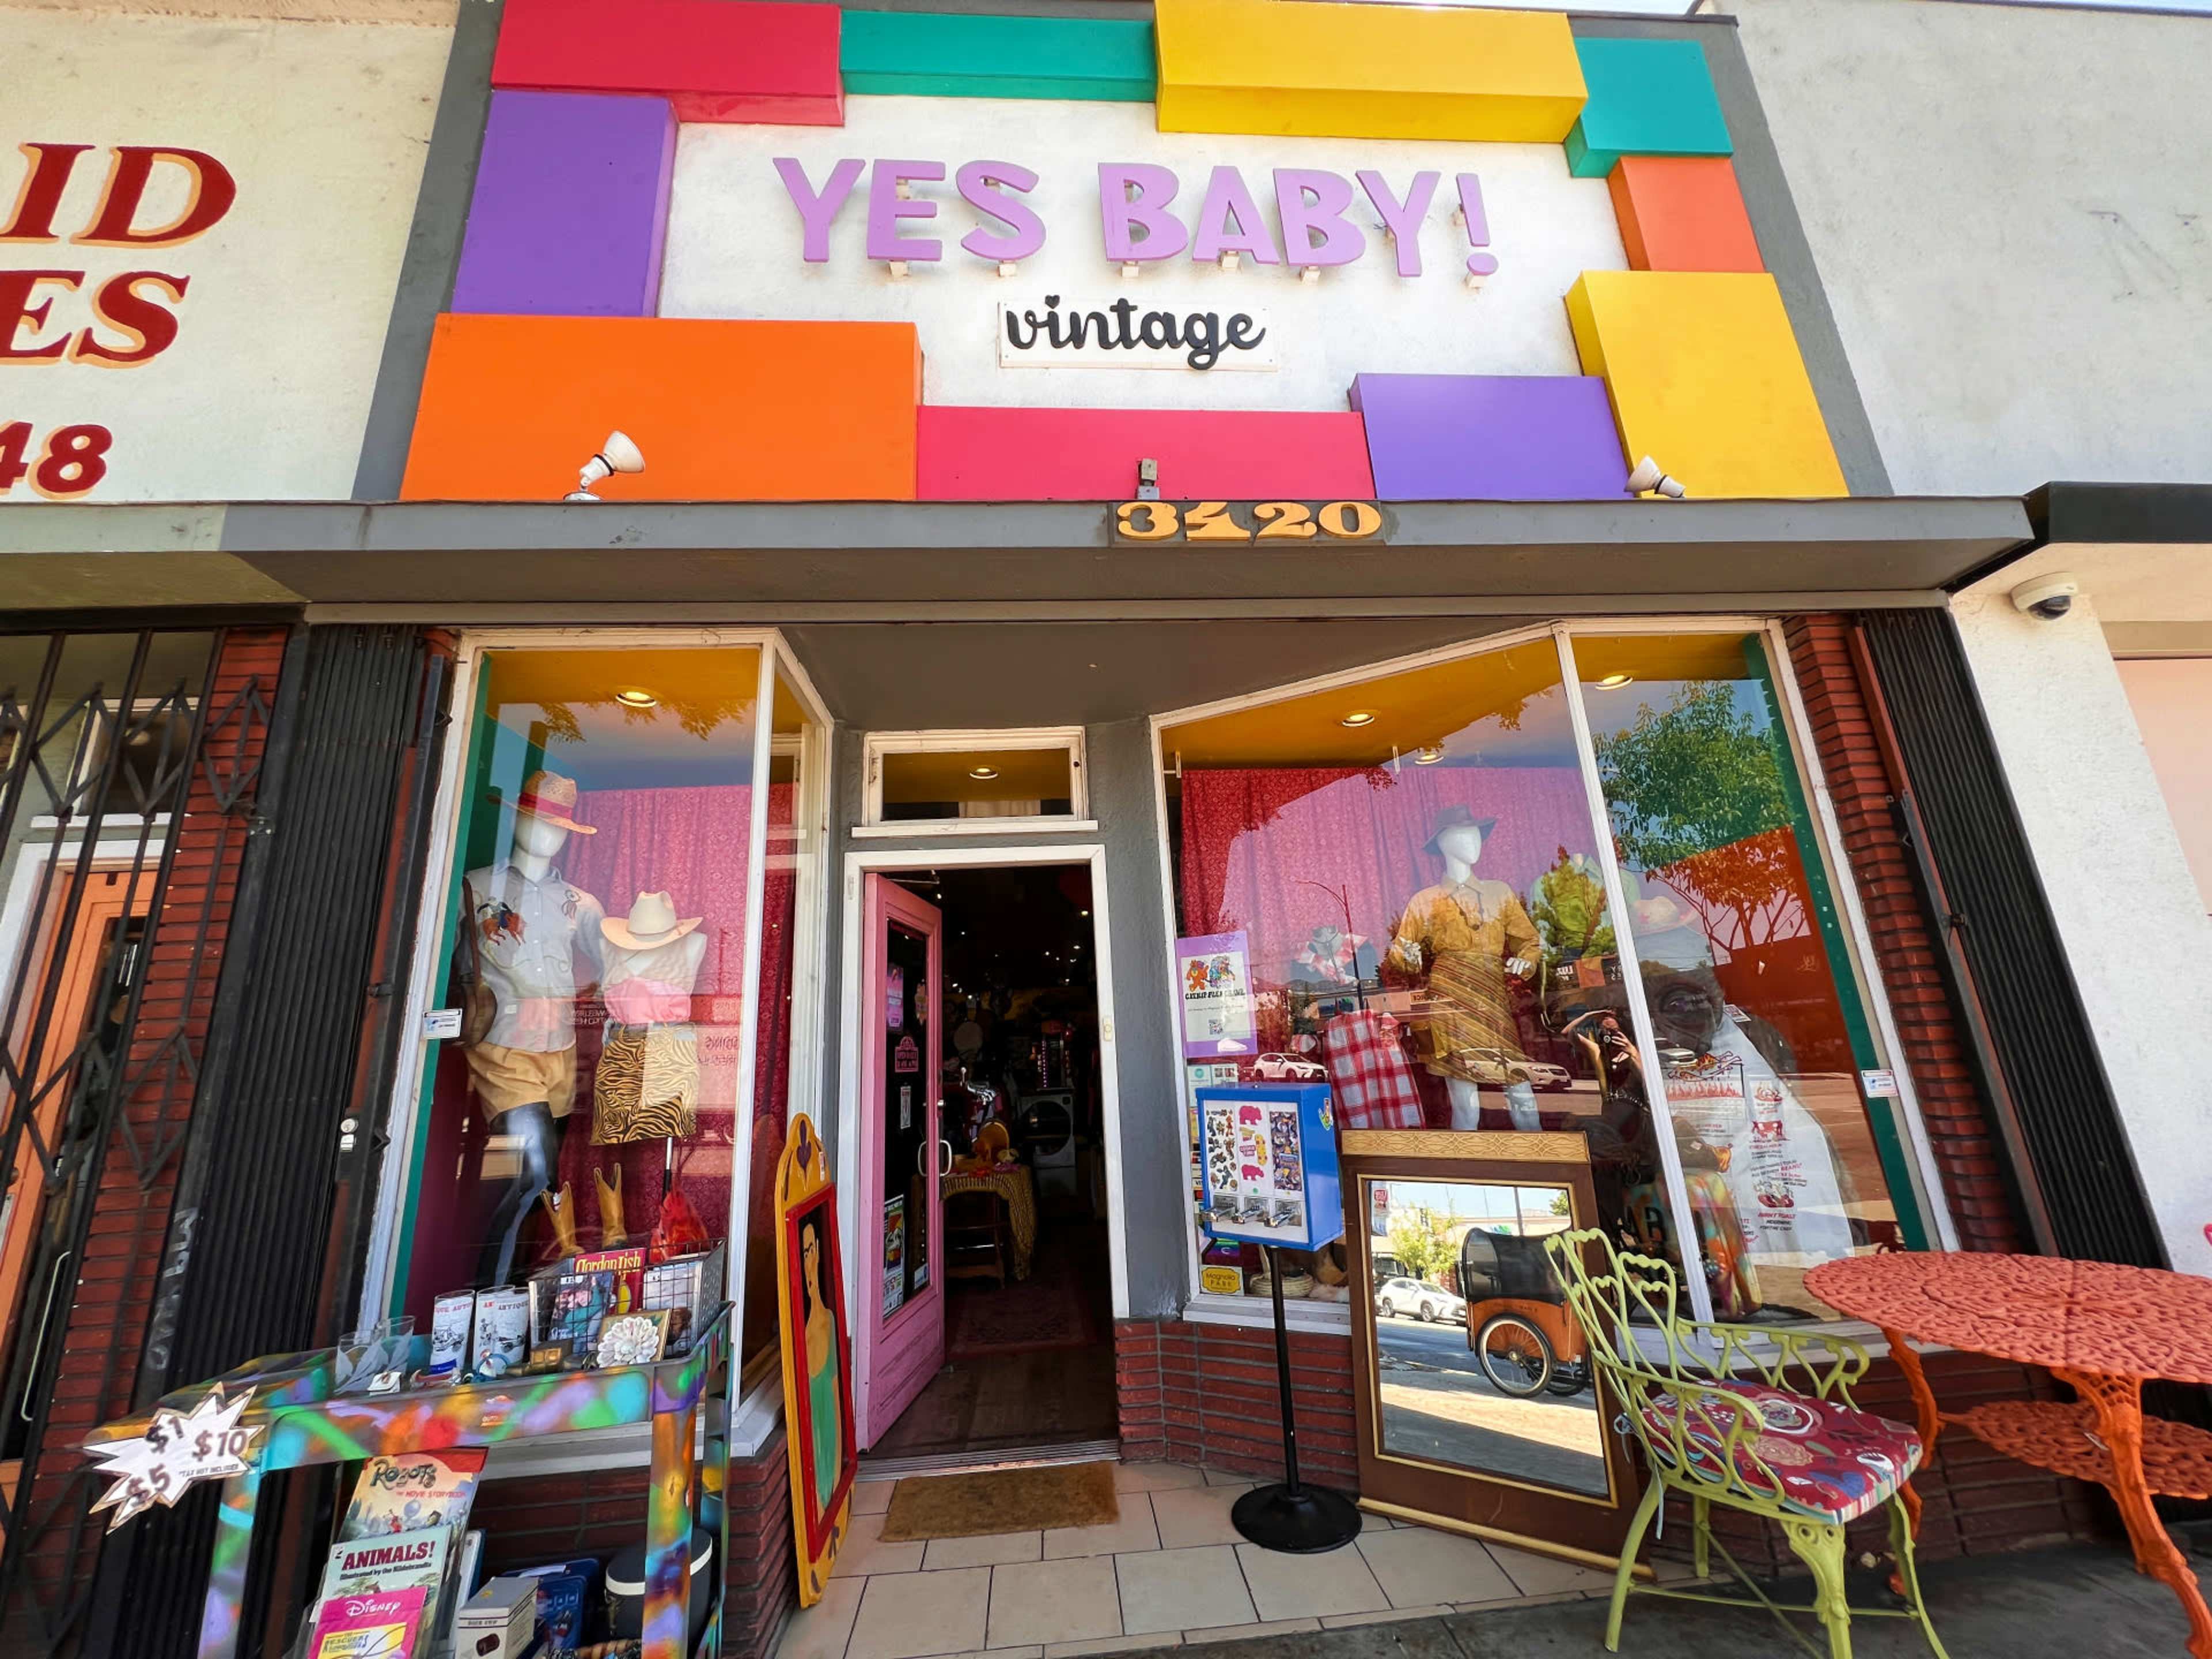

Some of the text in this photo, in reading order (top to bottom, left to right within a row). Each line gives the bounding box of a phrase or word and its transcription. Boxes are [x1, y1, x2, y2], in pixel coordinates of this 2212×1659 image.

[772, 157, 1499, 276] YES BABY!
[1006, 294, 1266, 370] vintage
[146, 1416, 184, 1455] $1
[192, 1430, 248, 1462] $10
[126, 1463, 171, 1507] $5
[342, 1541, 436, 1571] ANIMALS!
